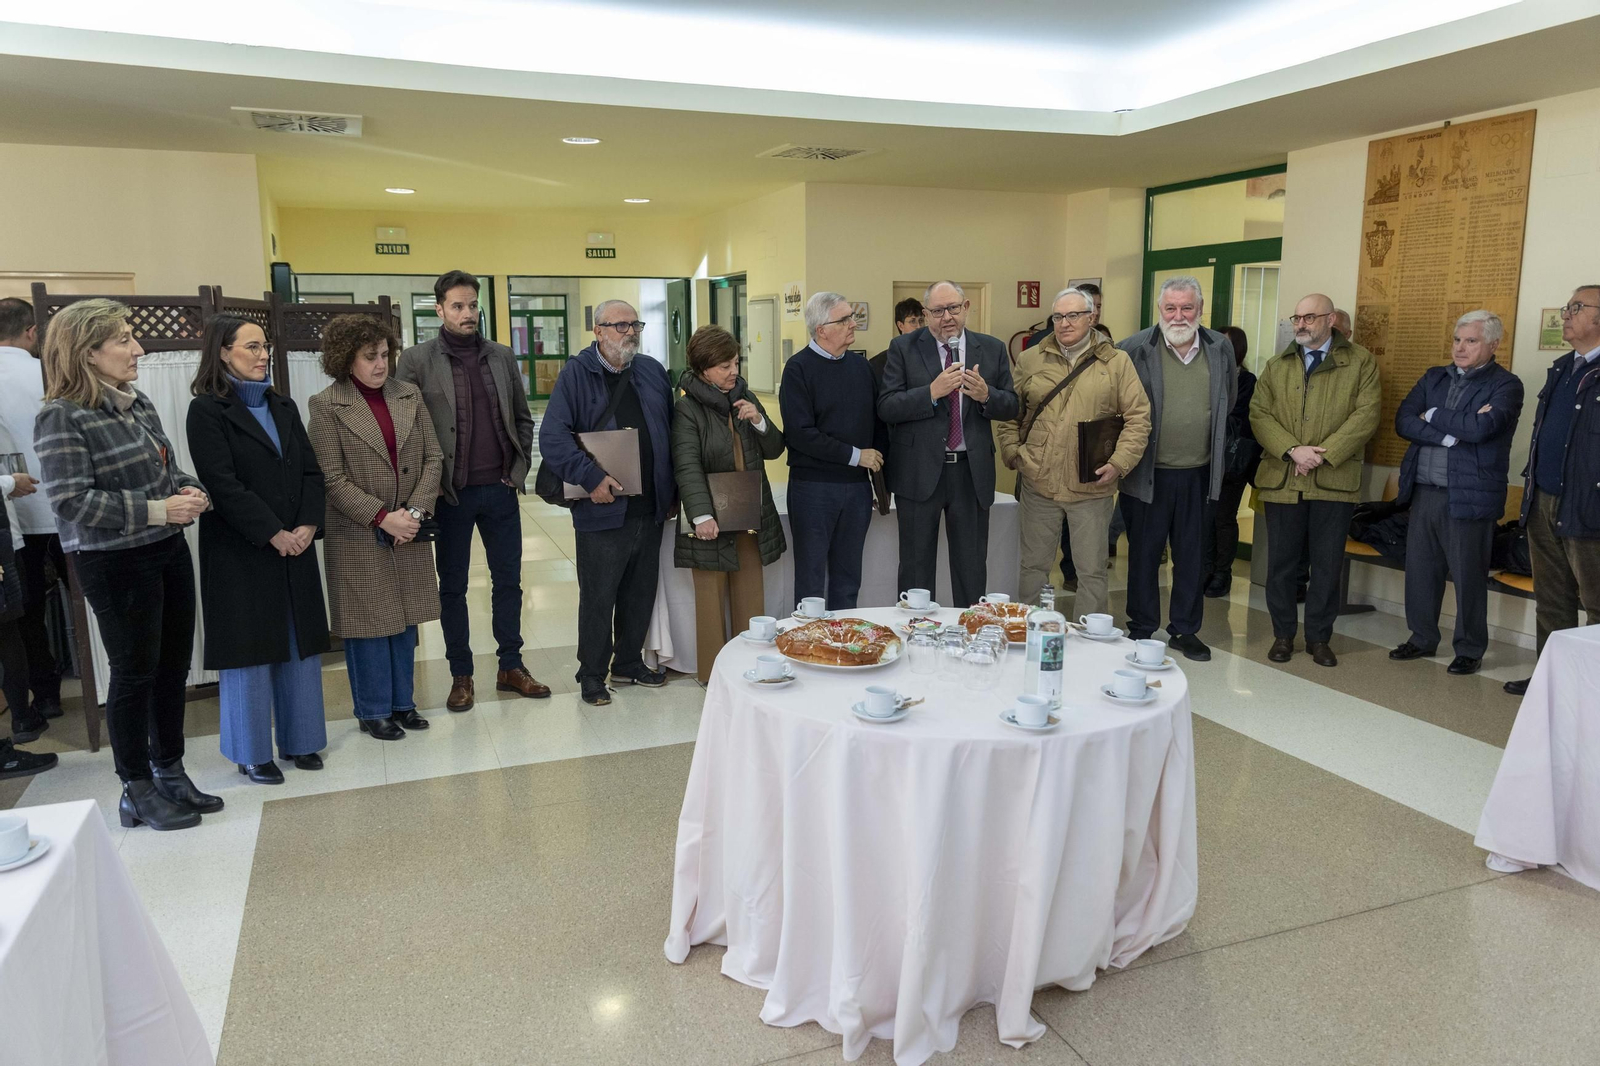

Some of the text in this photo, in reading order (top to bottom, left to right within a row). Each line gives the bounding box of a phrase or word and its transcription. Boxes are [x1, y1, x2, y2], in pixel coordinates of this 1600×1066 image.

[1485, 168, 1521, 178] MELBOURNE
[1404, 192, 1433, 200] LONDON
[377, 244, 408, 254] SALIDA
[587, 249, 614, 258] SALIDA
